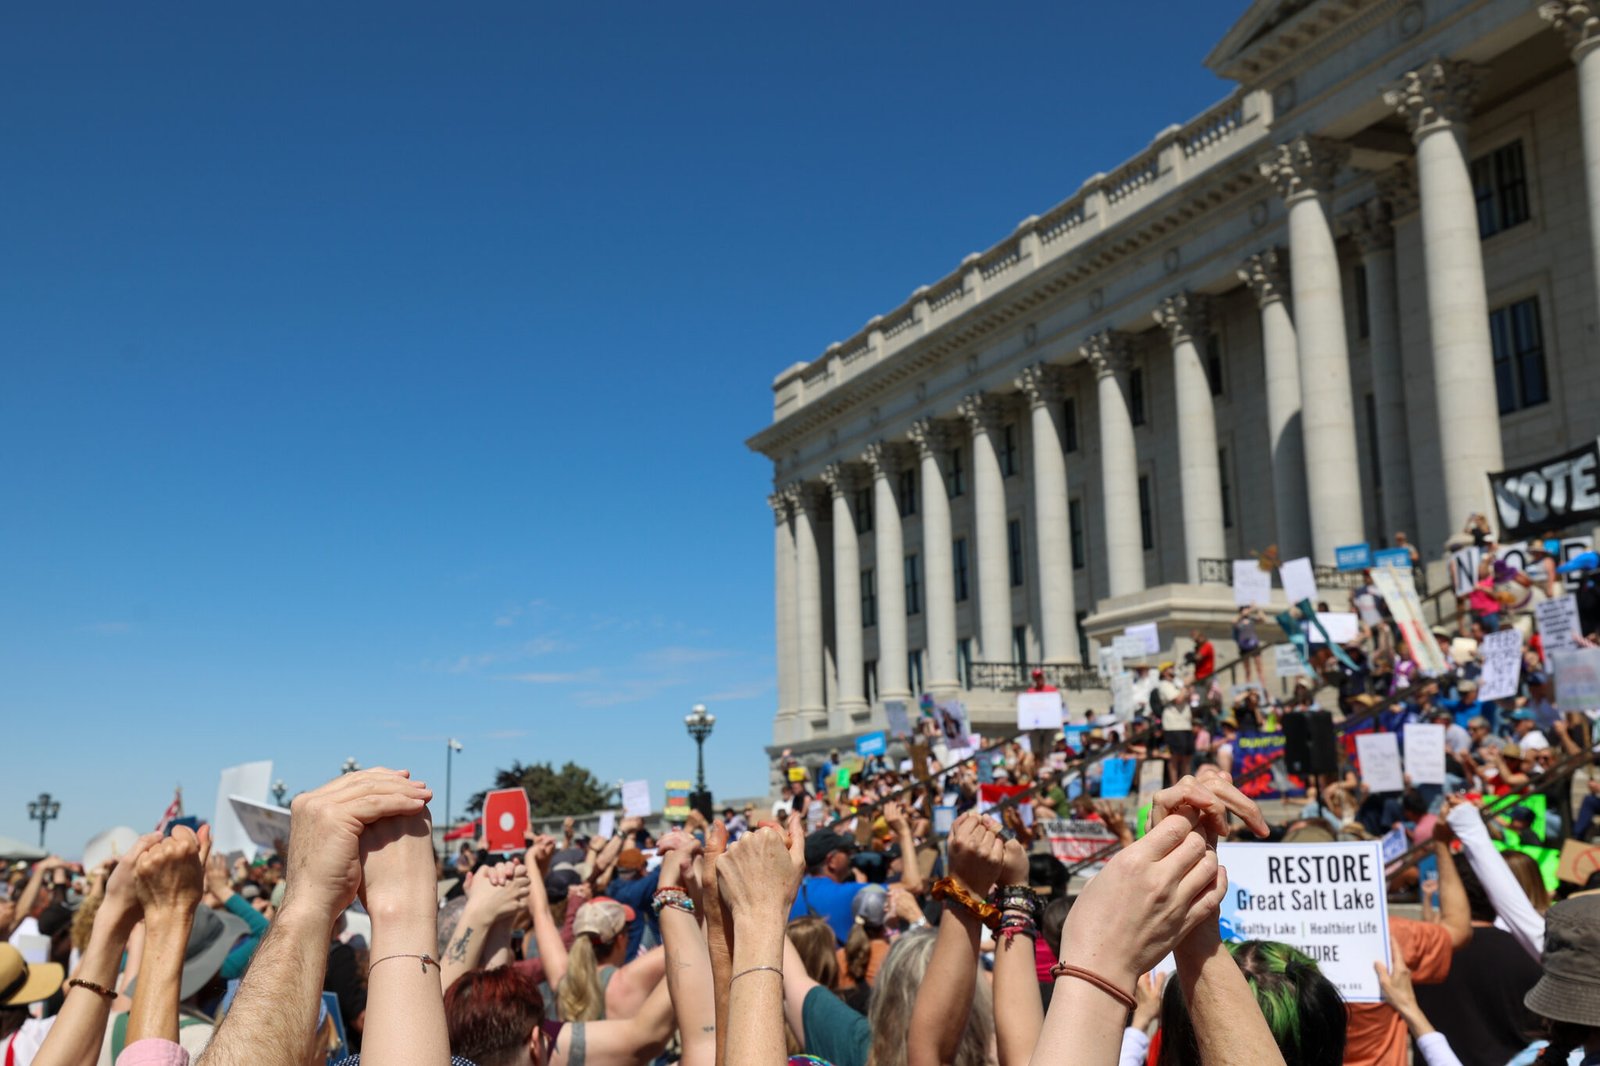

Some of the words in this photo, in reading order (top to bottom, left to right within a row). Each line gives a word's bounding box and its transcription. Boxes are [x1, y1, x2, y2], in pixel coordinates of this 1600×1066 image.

[1494, 452, 1600, 529] VOTE
[1268, 854, 1371, 884] RESTORE
[1236, 889, 1285, 911] Great
[1291, 888, 1327, 910] Salt
[1333, 888, 1375, 910] Lake
[1235, 922, 1271, 937] Healthy
[1274, 922, 1296, 935] Lake
[1310, 921, 1355, 935] Healthier
[1358, 920, 1377, 934] Life
